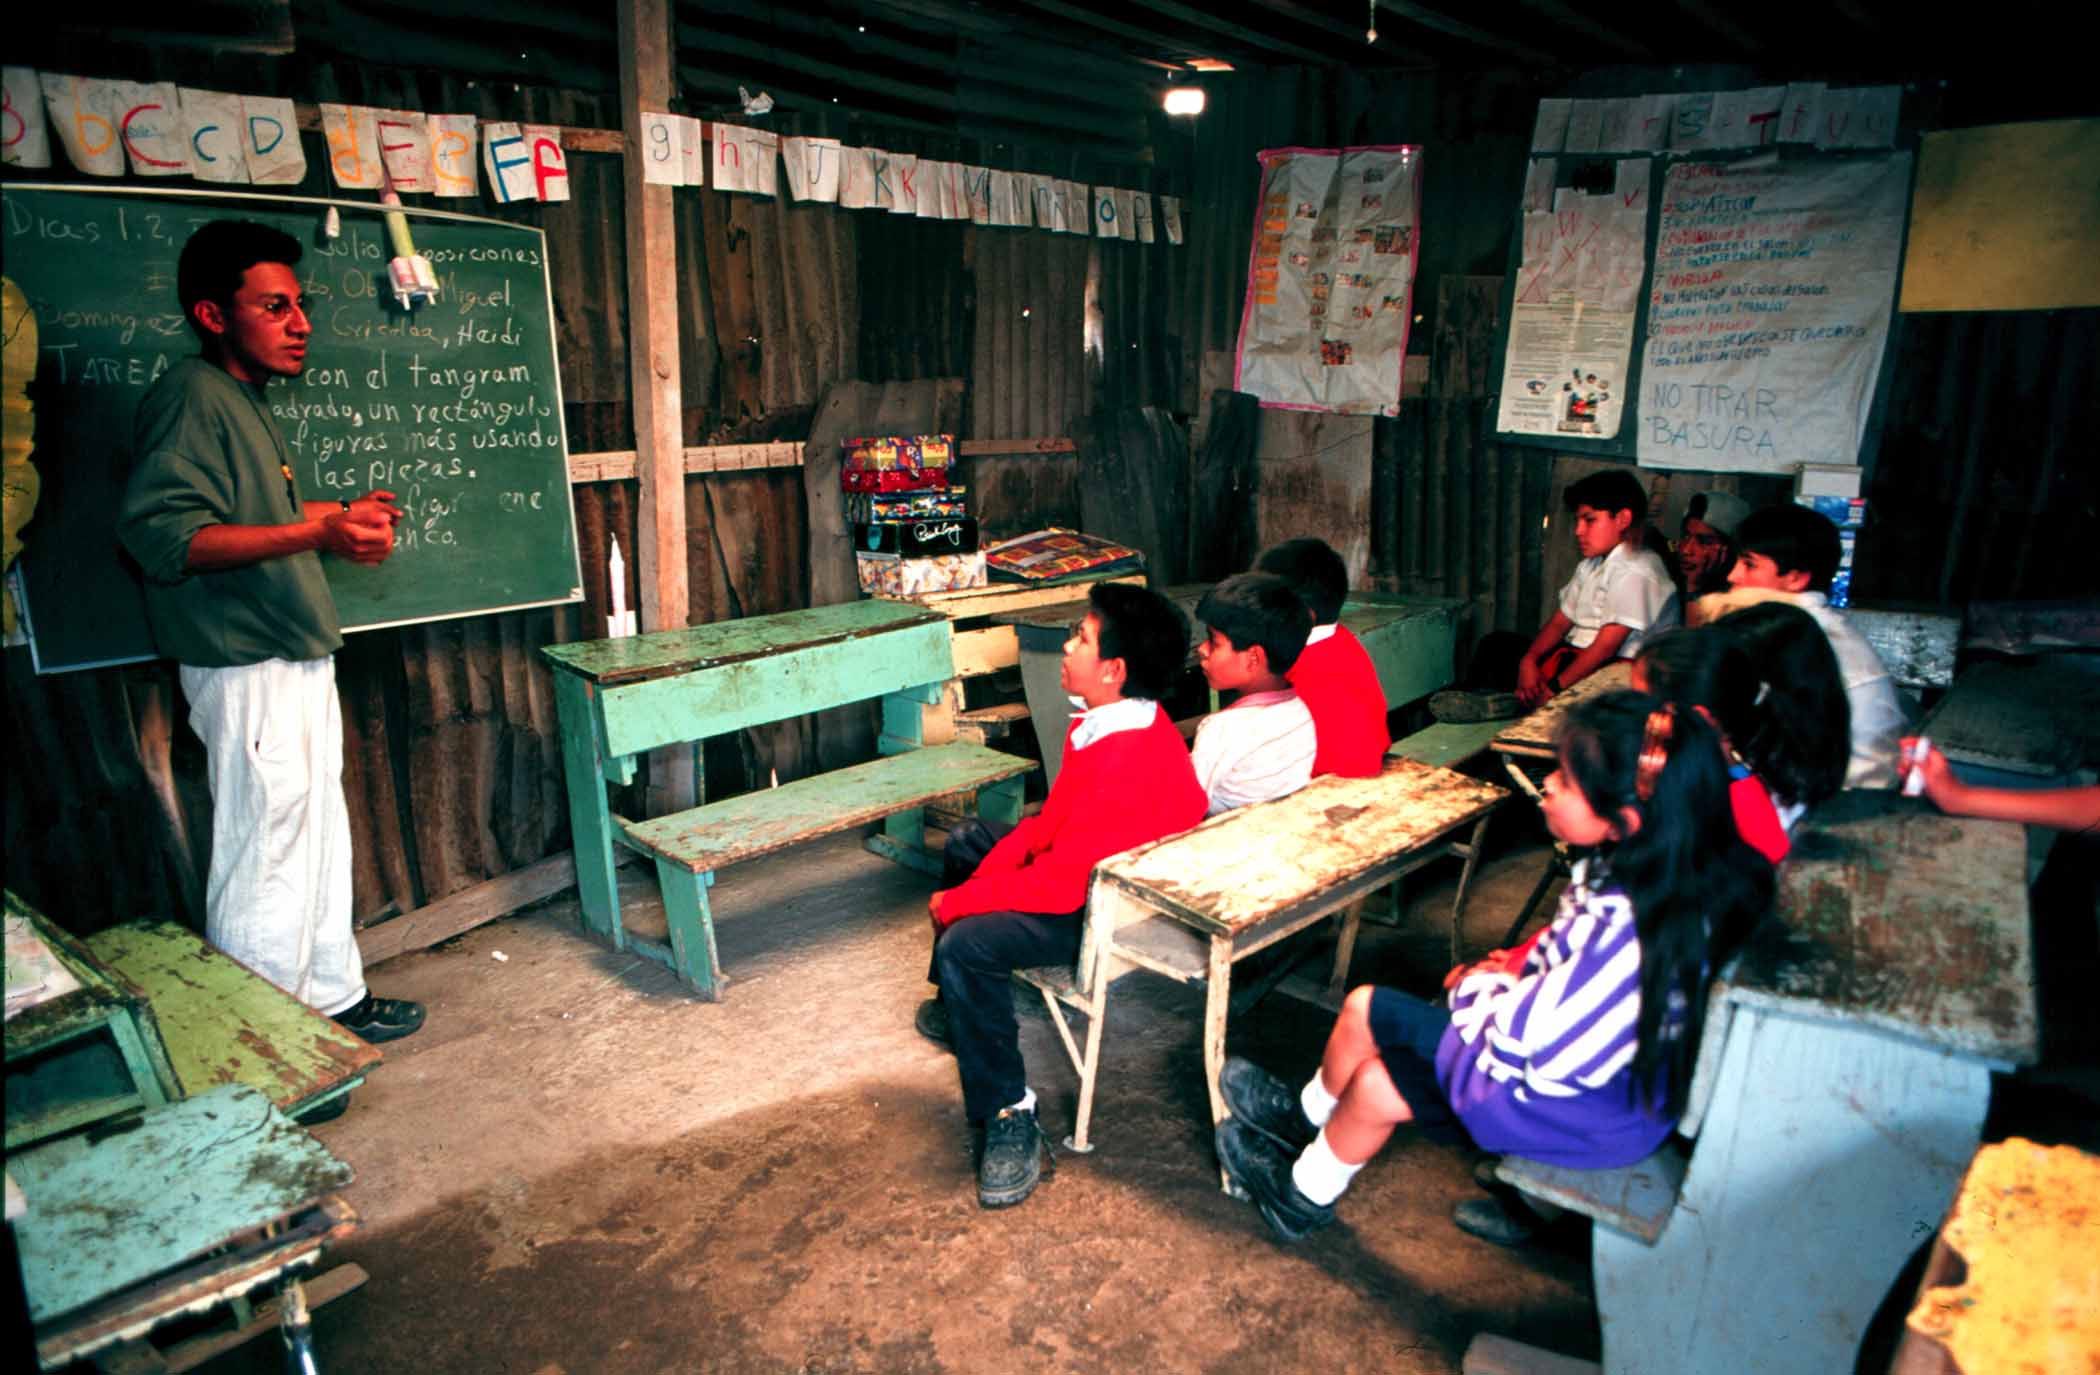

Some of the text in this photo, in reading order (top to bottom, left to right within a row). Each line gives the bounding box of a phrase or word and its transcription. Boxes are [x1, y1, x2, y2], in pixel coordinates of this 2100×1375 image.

[71, 78, 116, 156] b
[121, 103, 187, 168] C
[249, 116, 284, 155] D
[431, 130, 475, 188] e
[489, 135, 530, 201] F
[719, 130, 740, 169] h
[304, 367, 350, 389] con
[365, 352, 389, 390] el
[368, 402, 401, 422] un
[1653, 384, 1778, 419] NO TIRAR
[472, 420, 559, 449] usando
[1646, 415, 1777, 456] BASURA
[313, 461, 356, 490] las
